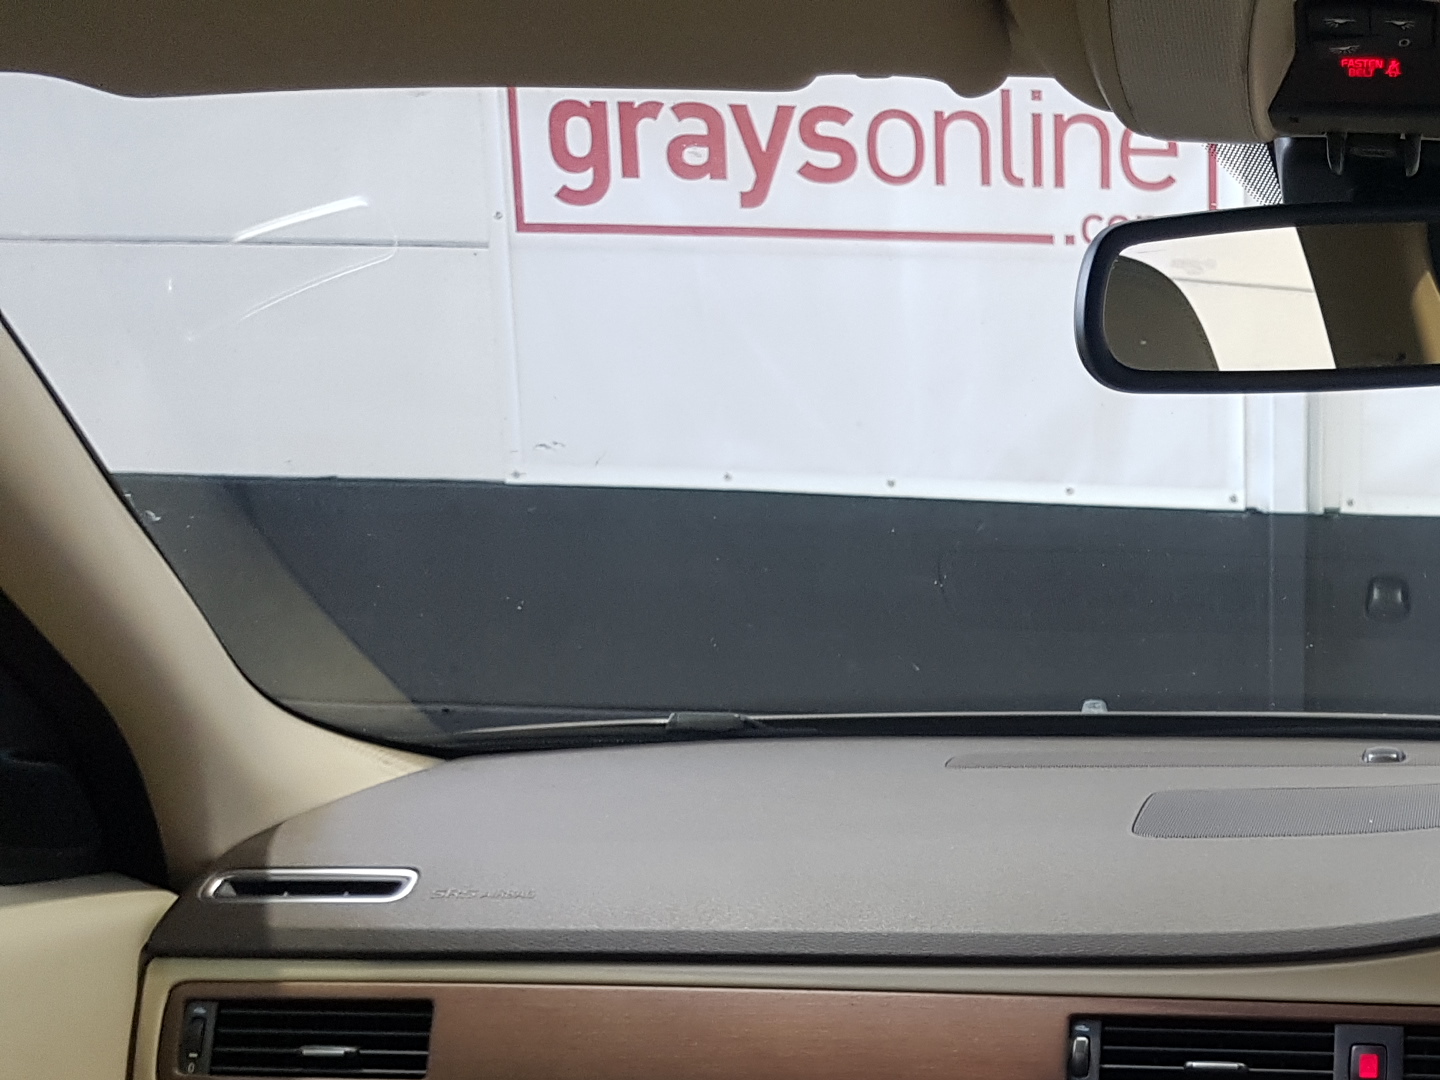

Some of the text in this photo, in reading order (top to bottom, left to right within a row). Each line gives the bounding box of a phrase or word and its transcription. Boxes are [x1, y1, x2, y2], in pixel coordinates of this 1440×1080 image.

[1340, 58, 1385, 68] FASTEN
[1348, 67, 1375, 78] BELT
[548, 88, 1178, 209] graysonline
